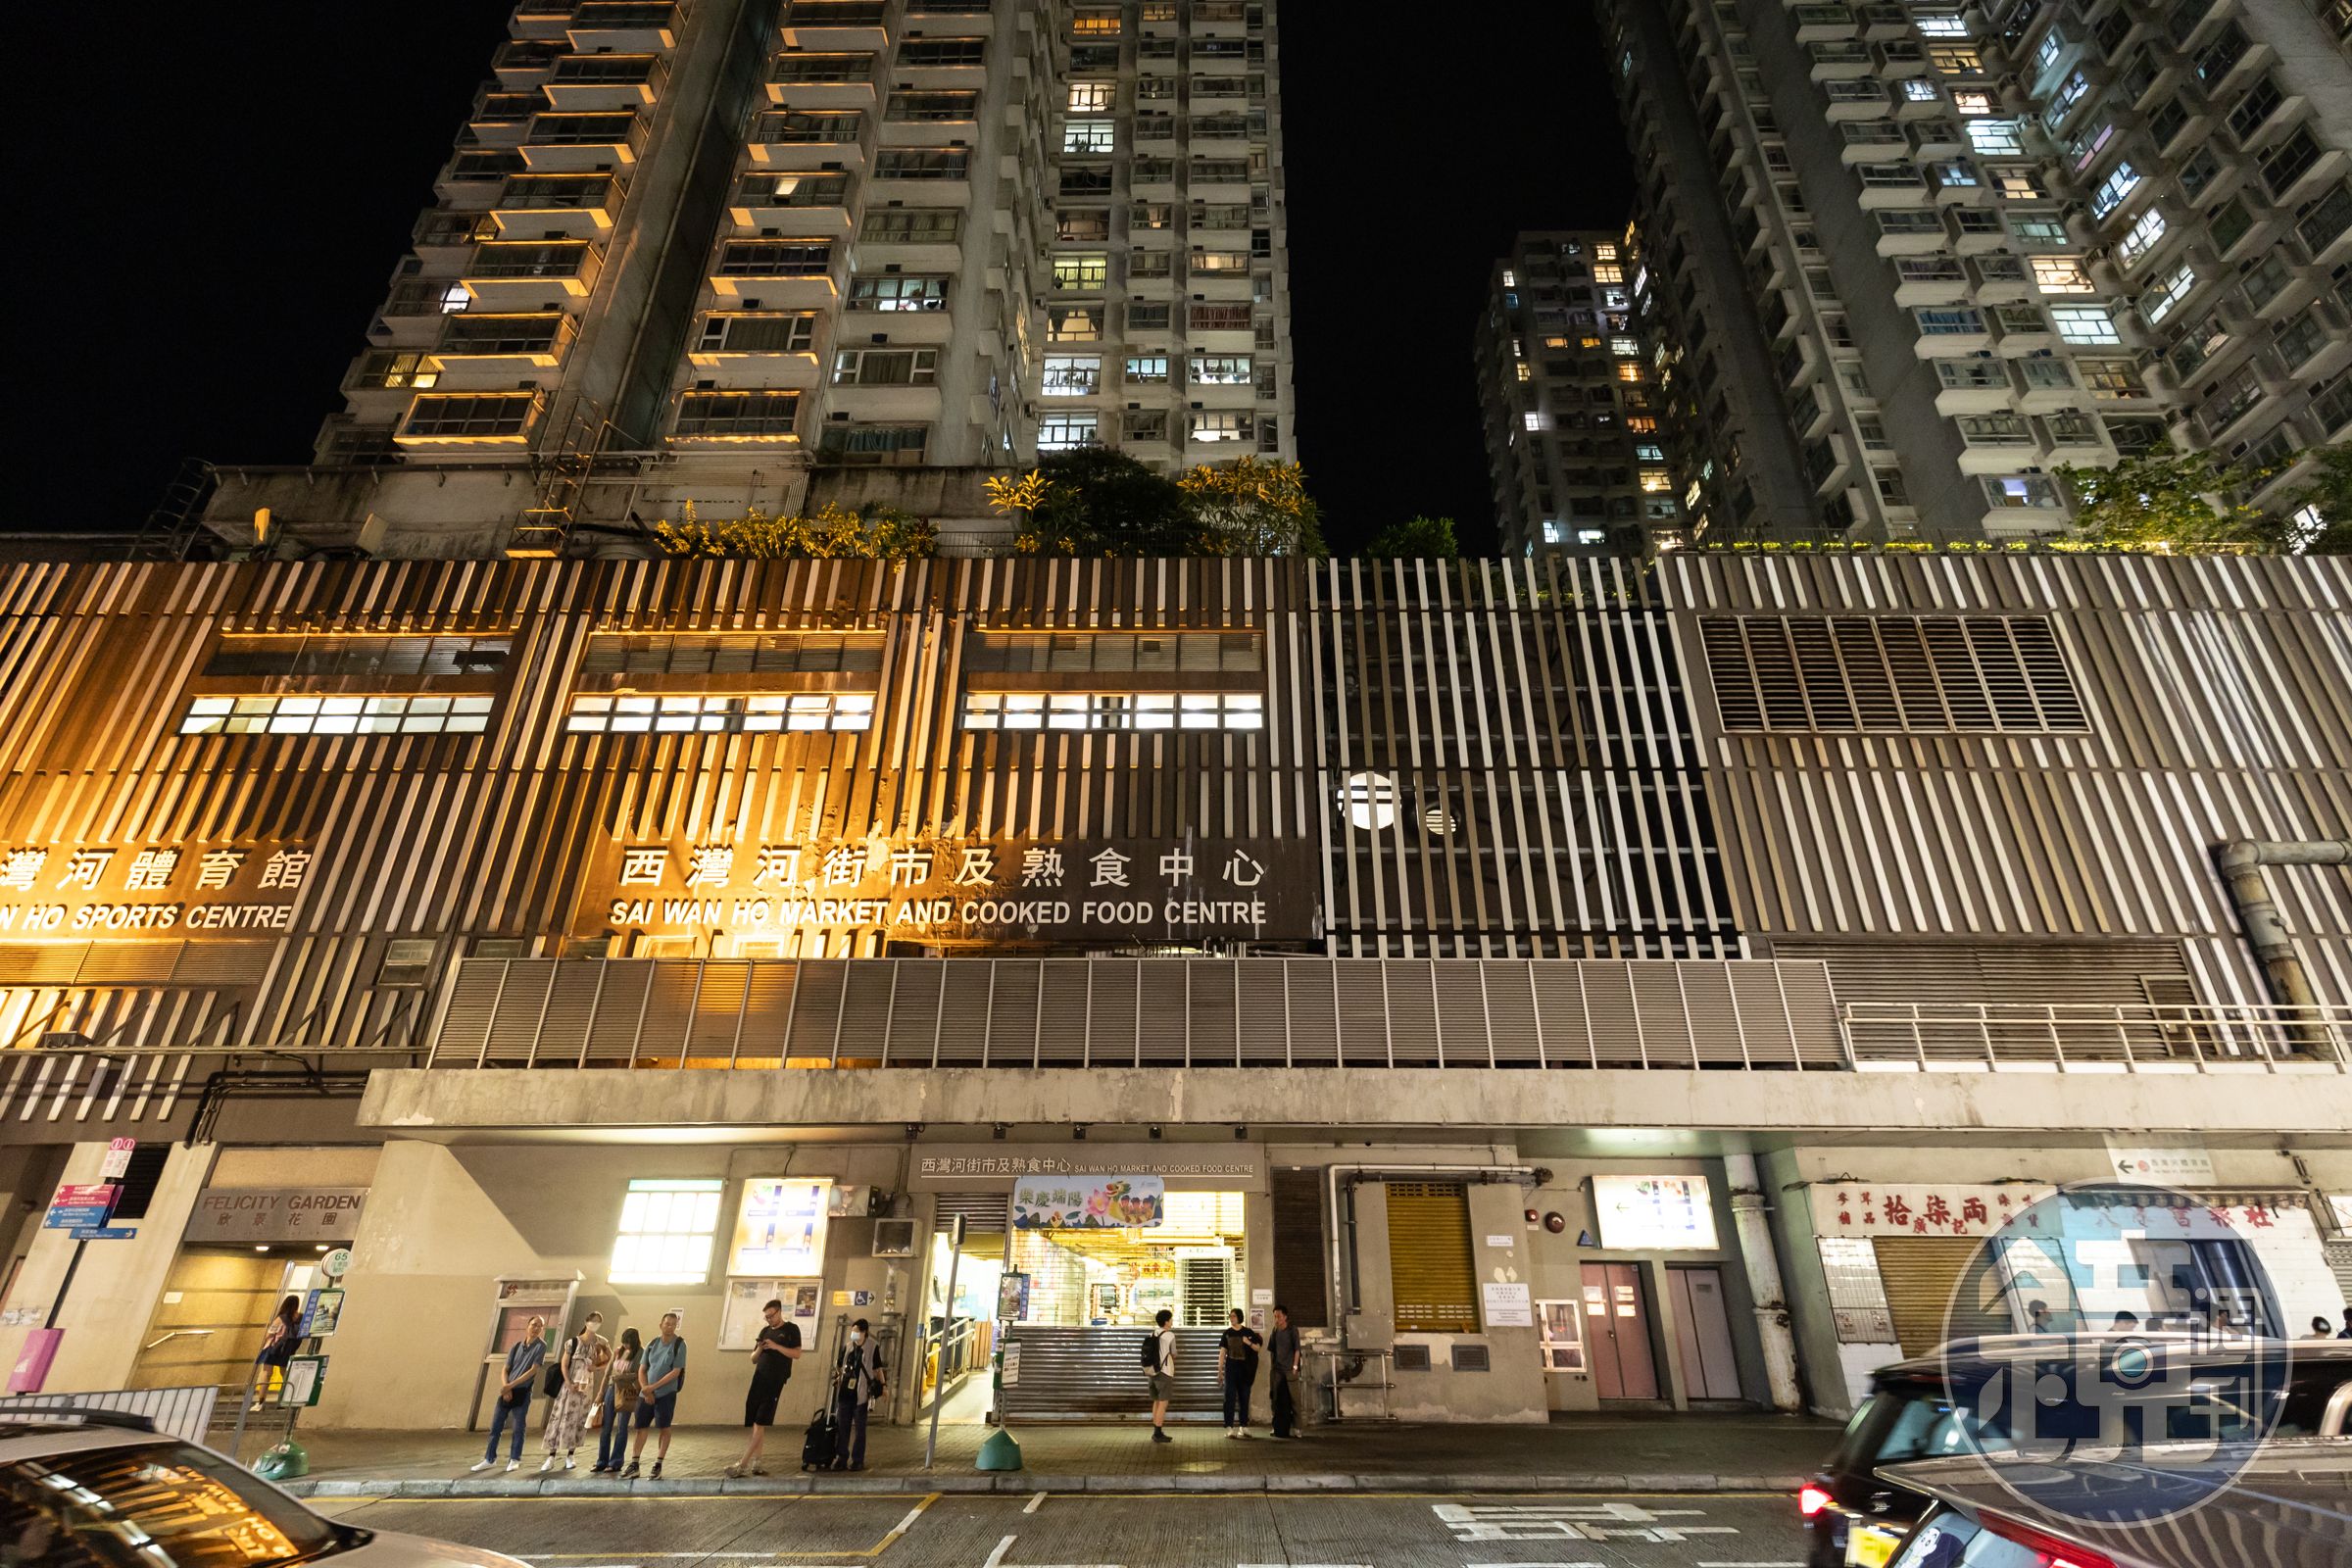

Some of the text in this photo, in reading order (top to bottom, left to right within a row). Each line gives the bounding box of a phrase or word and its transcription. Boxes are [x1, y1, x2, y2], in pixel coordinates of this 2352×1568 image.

[619, 847, 1265, 889] 西灣河街市及熟食中心
[22, 906, 67, 931] HO
[72, 905, 178, 930] SPORTS
[185, 905, 293, 929] CENTRE
[610, 900, 1267, 926] SAI WAN HO MARKET AND COOKED FOOD CENTRE
[920, 1157, 1072, 1174] 西灣河街市及熟食中心
[1074, 1164, 1254, 1173] SAI WAN HO MARKET AND COOKED FOOD CENTRE
[203, 1195, 362, 1210] FELICITY GARDEN
[334, 1252, 348, 1261] 65
